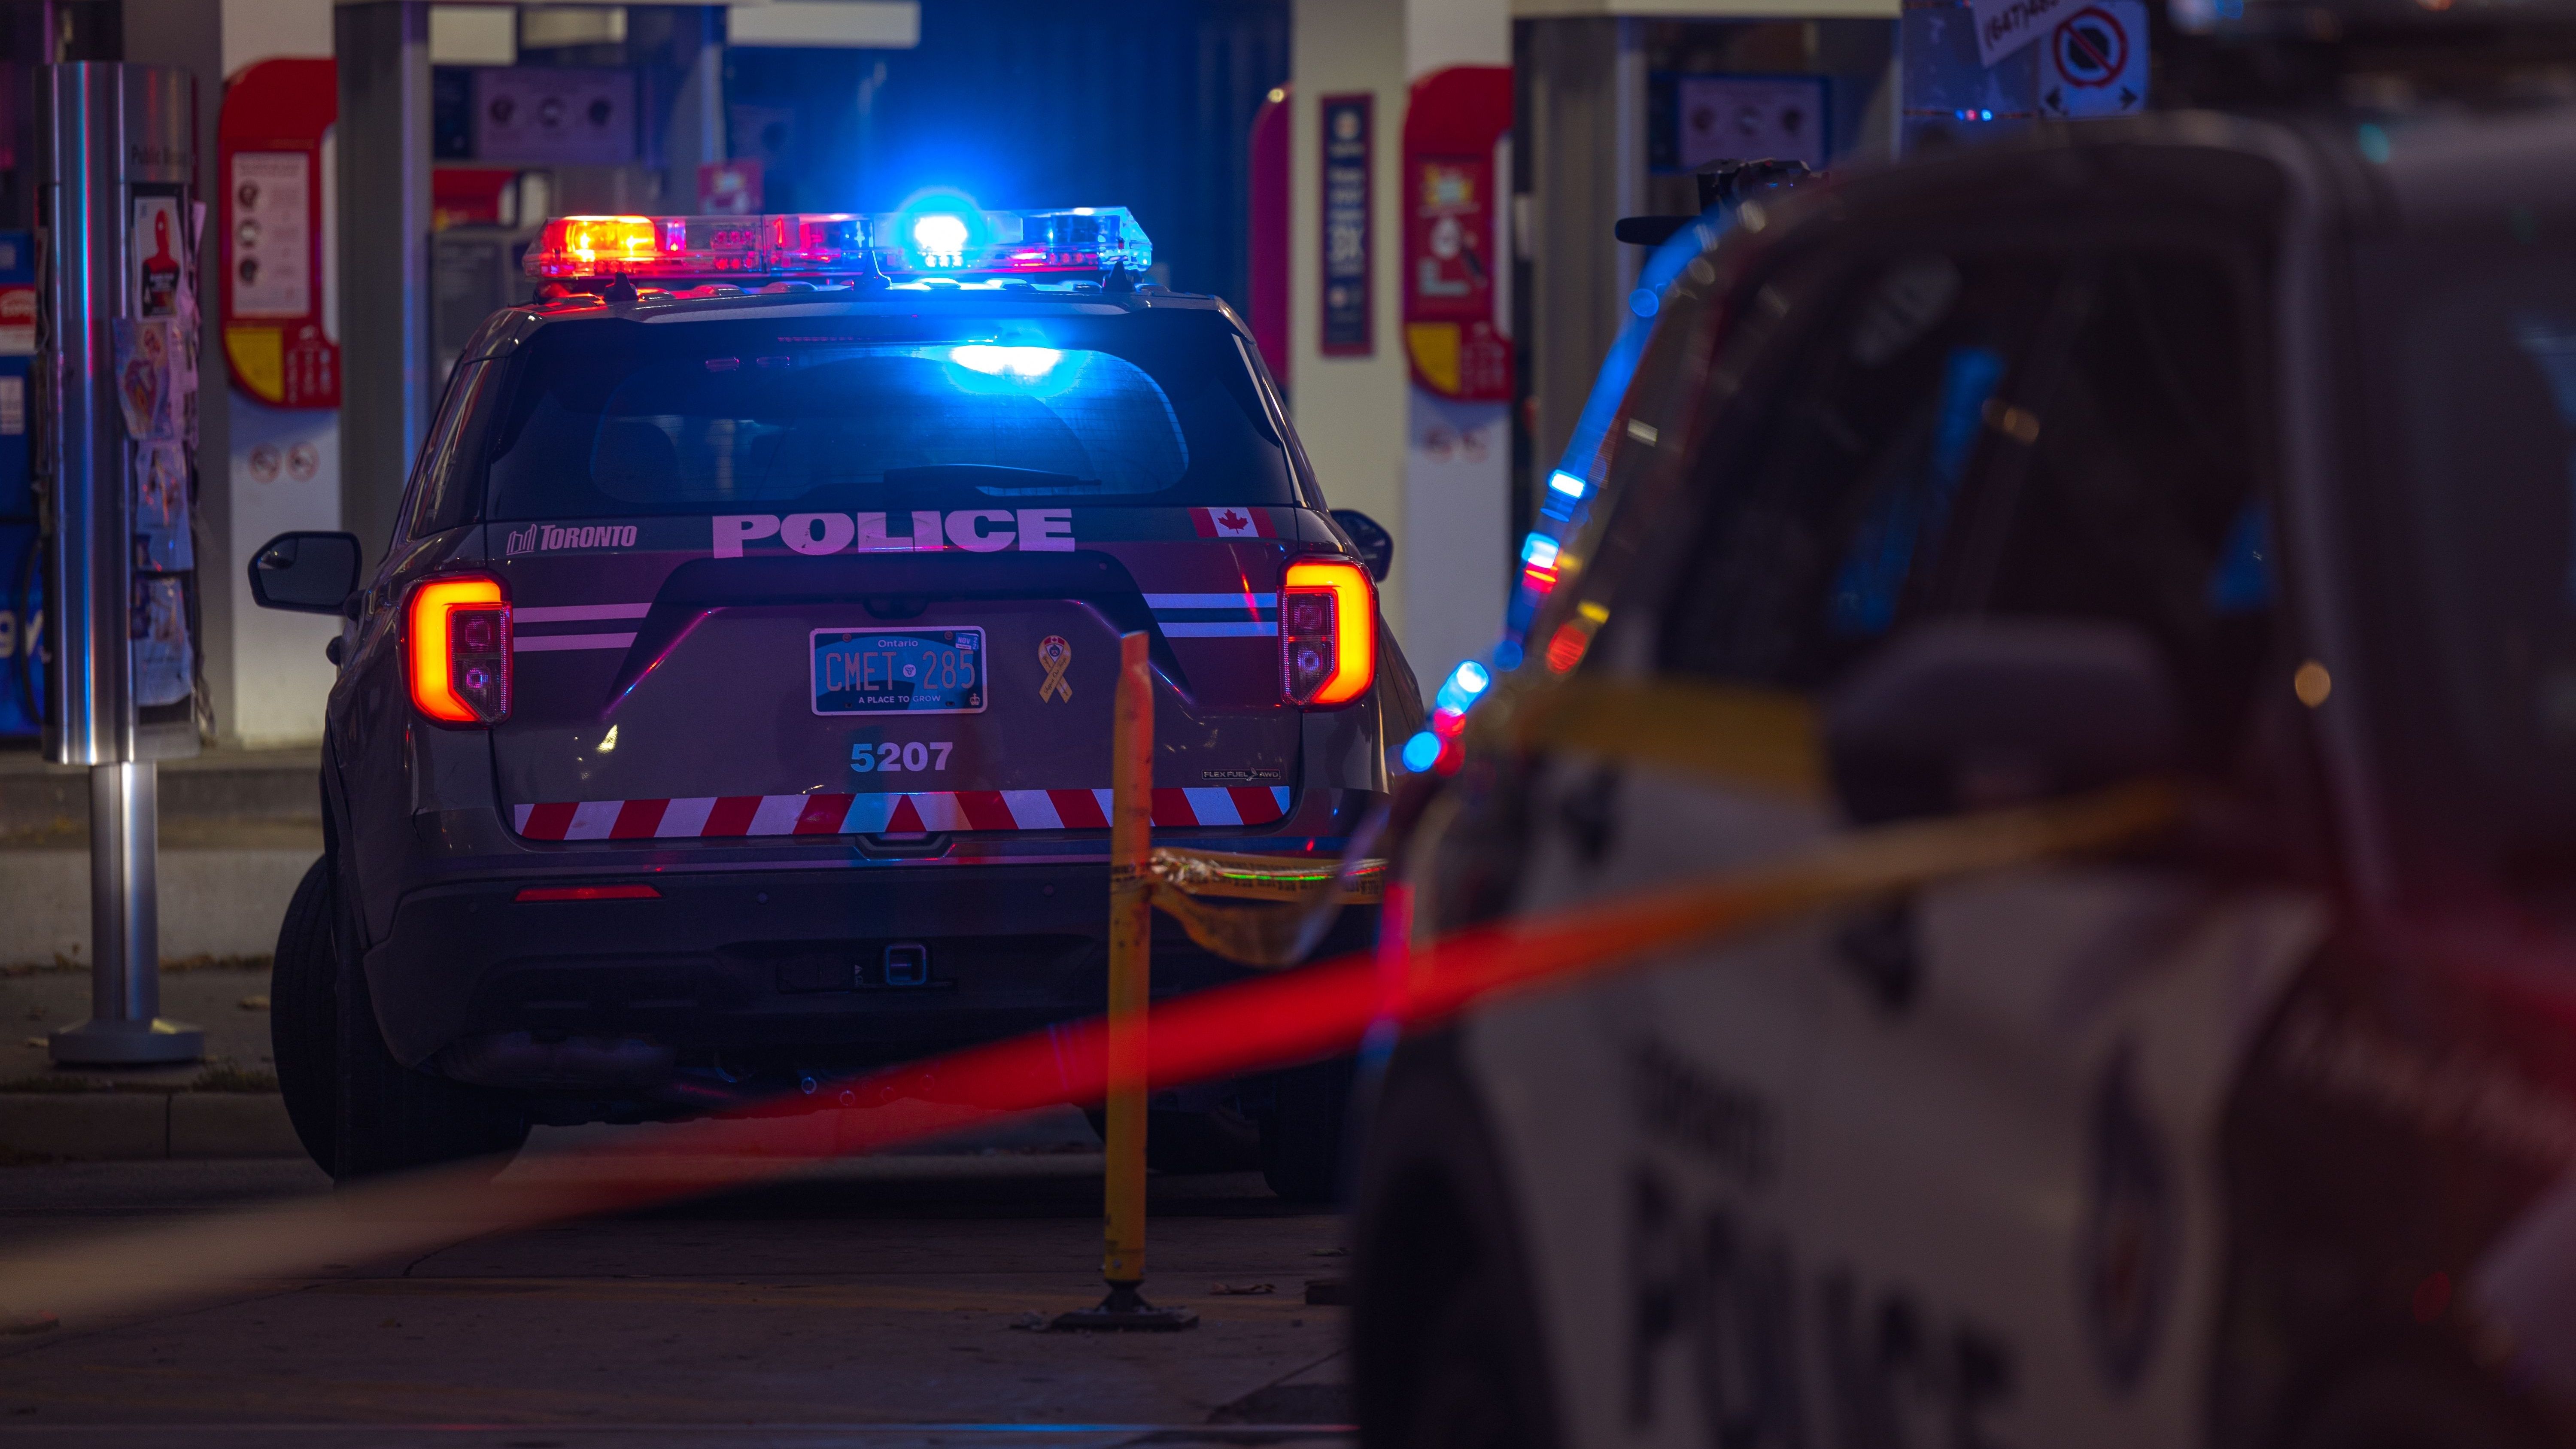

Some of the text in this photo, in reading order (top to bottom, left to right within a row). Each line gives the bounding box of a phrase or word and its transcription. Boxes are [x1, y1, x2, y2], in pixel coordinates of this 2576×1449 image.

[541, 525, 638, 550] TORONTO
[712, 509, 1075, 559] POLICE
[878, 639, 918, 647] Ontario
[826, 650, 975, 692] CMET 285
[1044, 679, 1054, 694] Support
[1057, 657, 1067, 670] Troops
[851, 742, 953, 772] 5207
